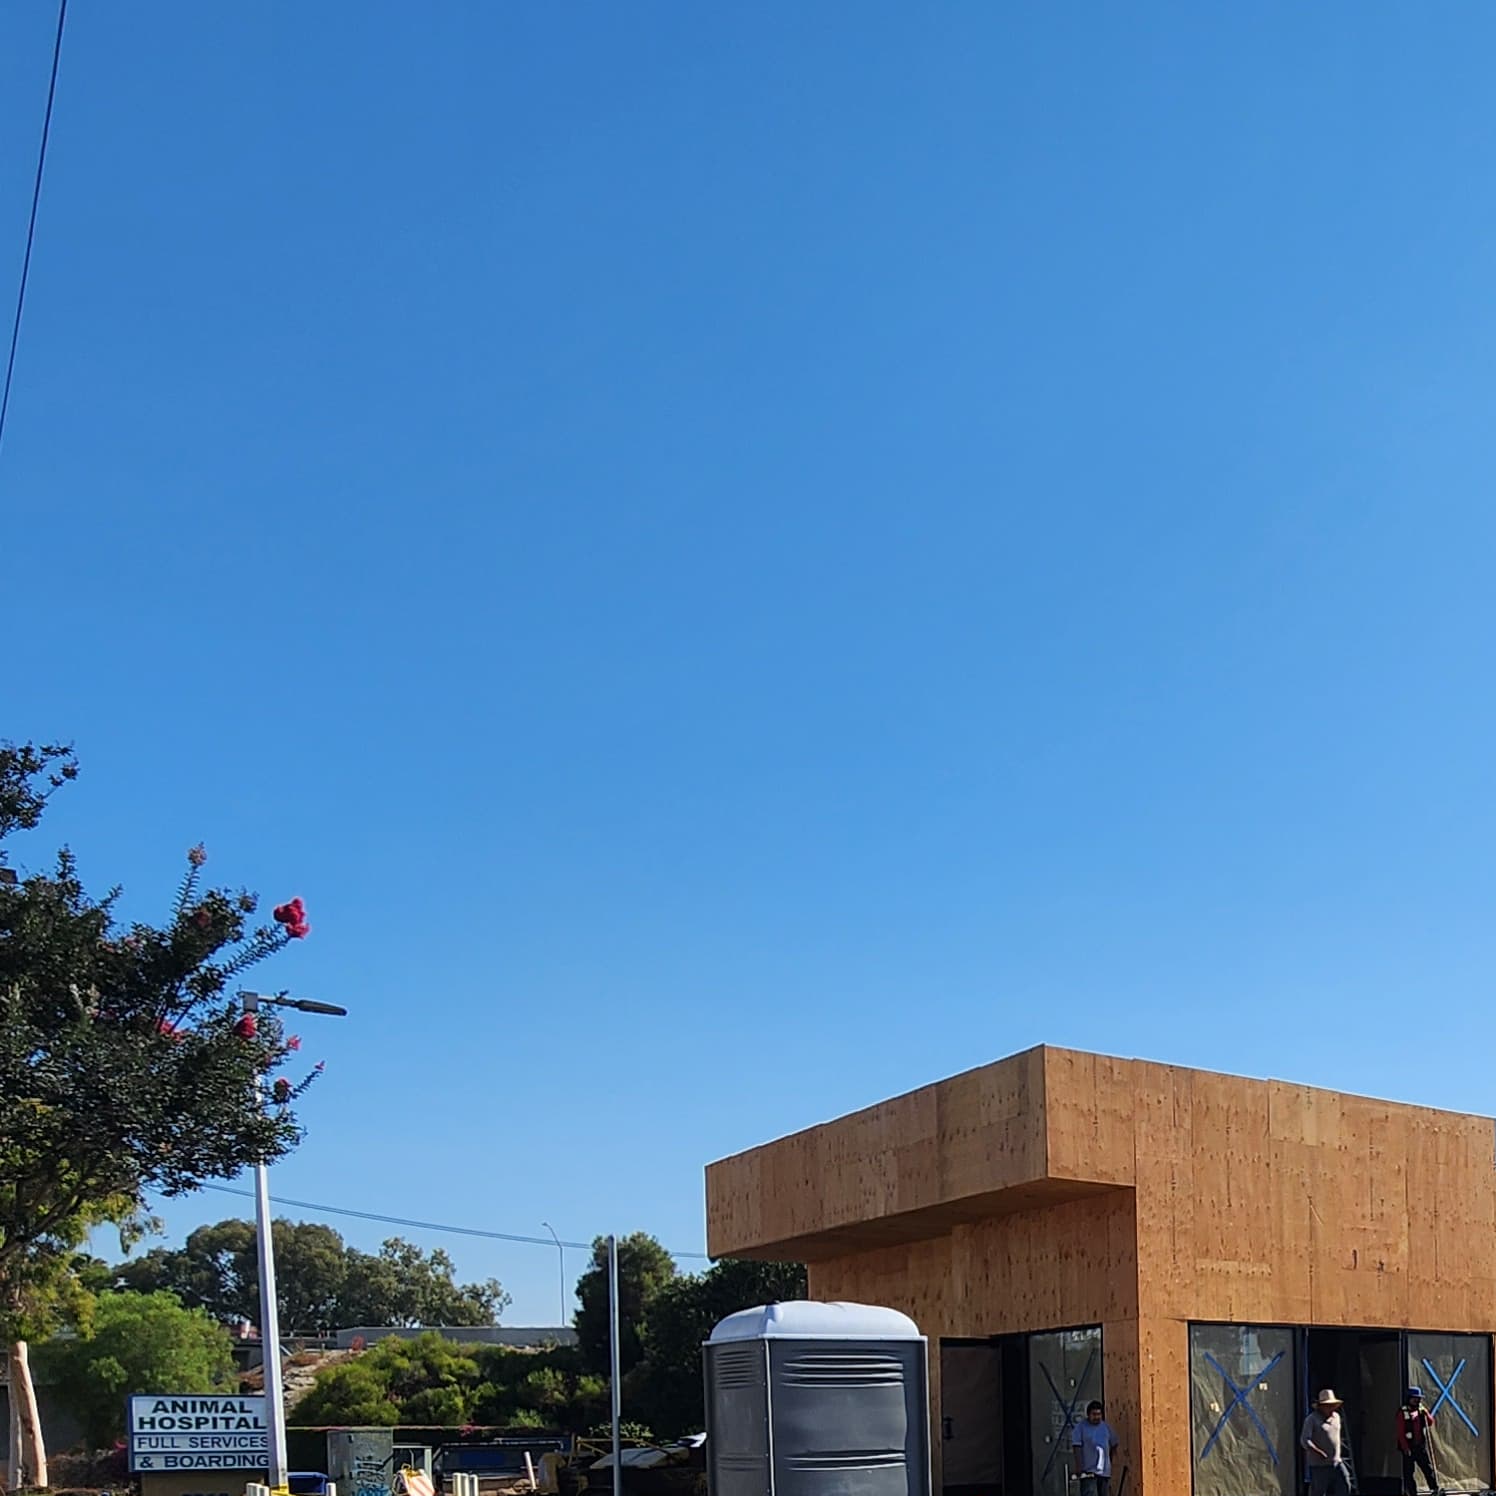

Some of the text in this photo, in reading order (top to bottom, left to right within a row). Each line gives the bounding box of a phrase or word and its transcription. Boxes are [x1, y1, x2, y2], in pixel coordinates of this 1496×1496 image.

[152, 1400, 253, 1414] ANIMAL
[138, 1416, 267, 1430] HOSPITAL
[138, 1436, 268, 1449] FULL SERVICES
[139, 1454, 270, 1469] & BOARDING
